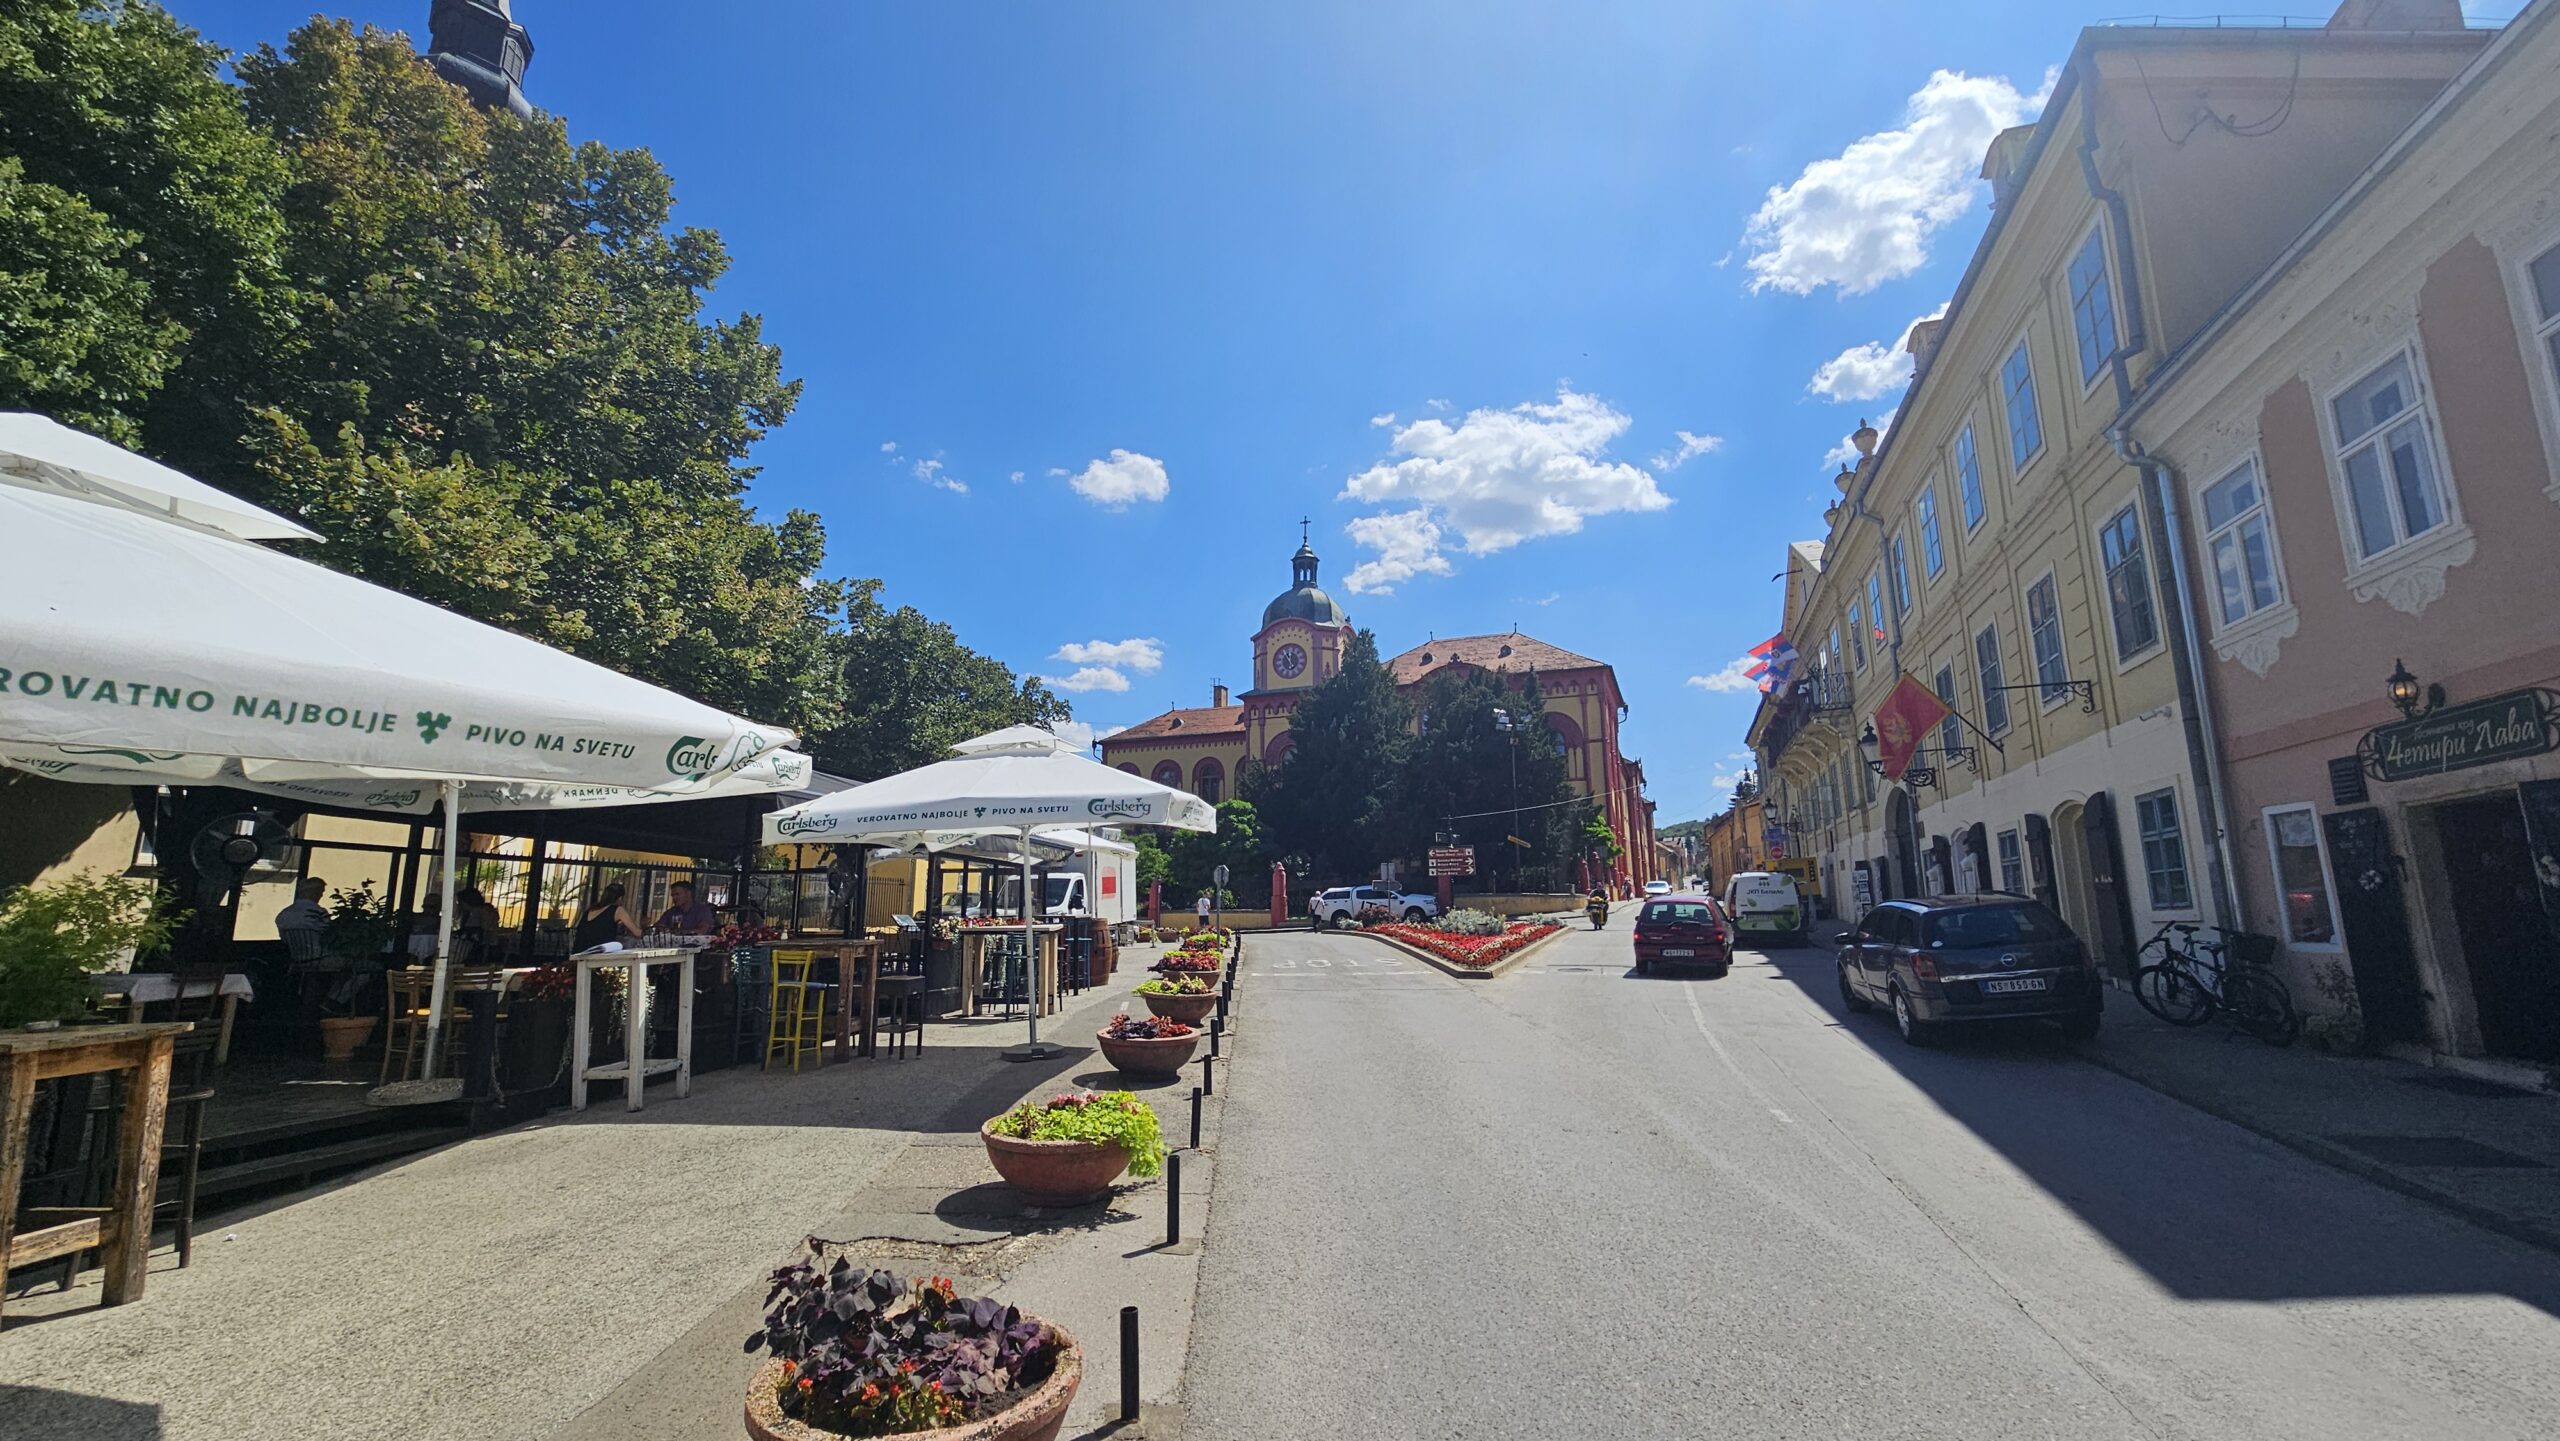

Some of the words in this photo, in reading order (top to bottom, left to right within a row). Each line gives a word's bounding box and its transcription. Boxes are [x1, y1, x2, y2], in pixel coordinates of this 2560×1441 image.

[232, 695, 398, 733] NAJBOLJE
[2474, 706, 2535, 752] Лава
[466, 724, 526, 748] PIVO
[535, 734, 565, 752] NA
[573, 738, 637, 760] SVETU
[857, 812, 918, 823] VEROVATNO
[921, 809, 969, 820] NAJBOLJE
[992, 807, 1018, 815] PIVO
[1020, 806, 1034, 814] NA
[1037, 805, 1069, 813] SVETU
[1088, 797, 1152, 819] Carlsberg
[777, 814, 838, 838] Carlsberg
[1272, 958, 1403, 969] STOP
[1990, 982, 2003, 991] NS
